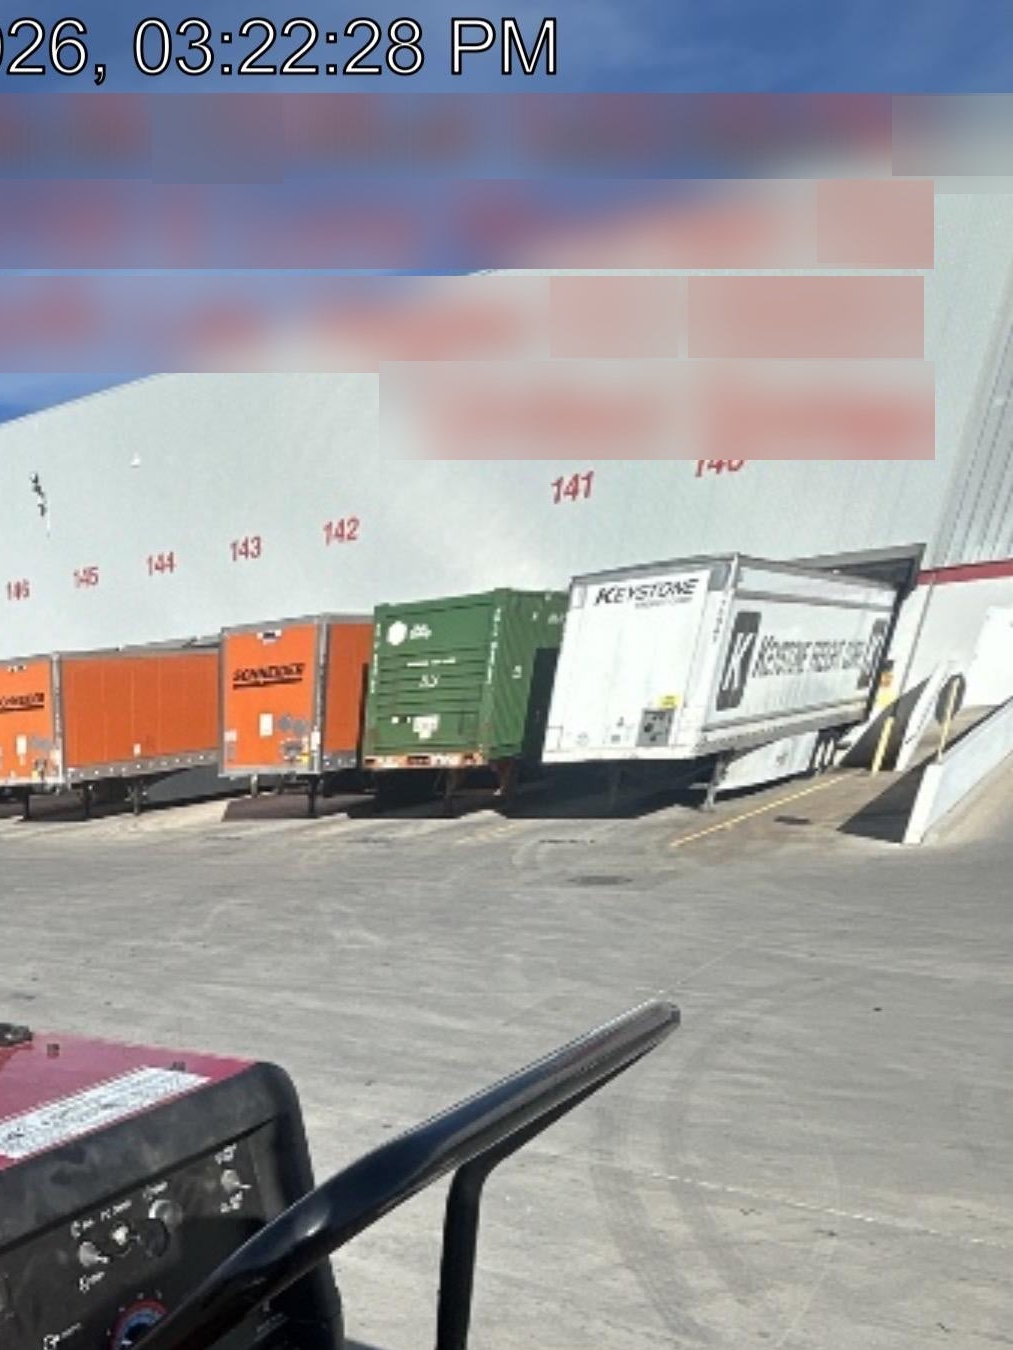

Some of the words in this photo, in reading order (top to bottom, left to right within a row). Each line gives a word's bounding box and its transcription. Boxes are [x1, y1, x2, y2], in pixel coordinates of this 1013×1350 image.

[550, 471, 594, 504] 141
[323, 517, 360, 546] 142
[230, 536, 262, 562] 143
[146, 551, 176, 576] 144
[594, 578, 700, 606] KEYSTONE
